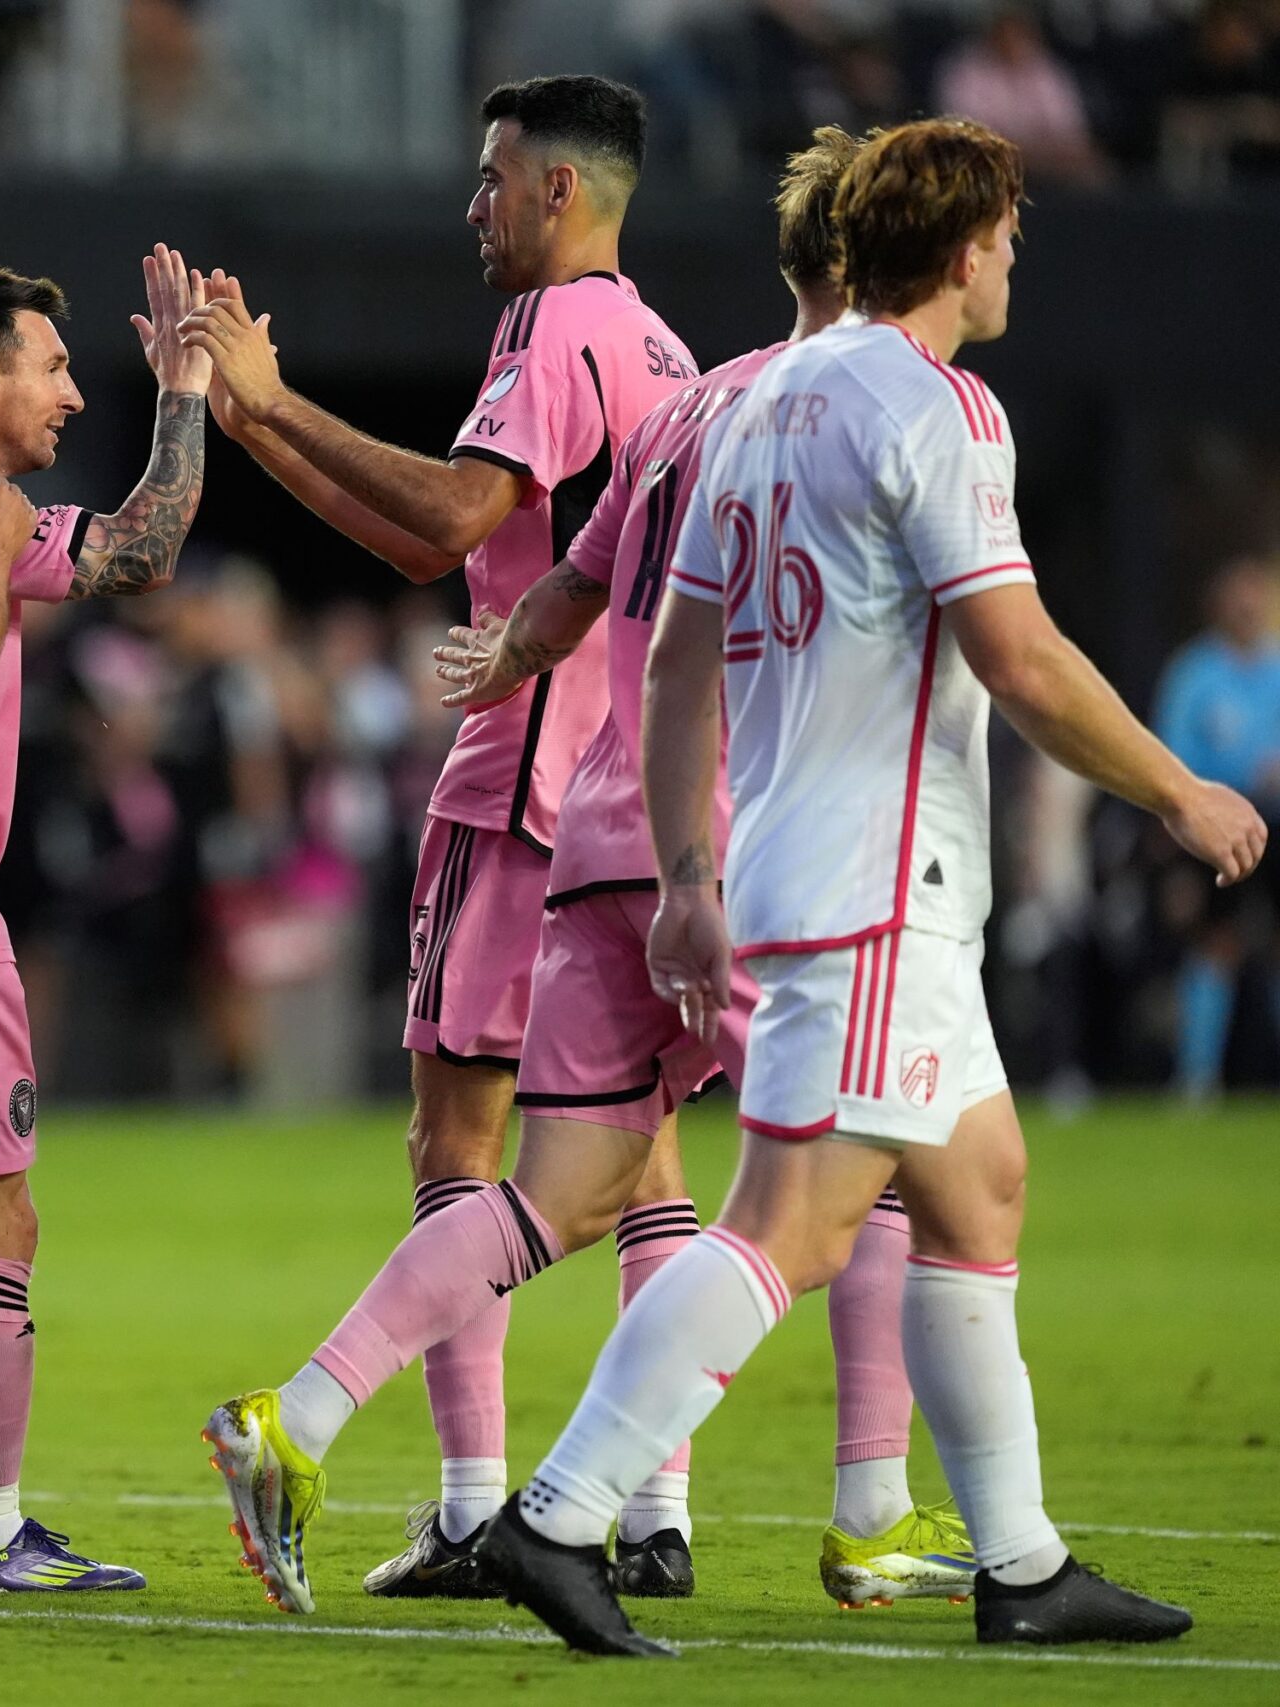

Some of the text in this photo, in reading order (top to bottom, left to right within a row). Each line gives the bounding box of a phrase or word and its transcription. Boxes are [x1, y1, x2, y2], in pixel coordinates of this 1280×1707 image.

[475, 414, 506, 437] tv
[713, 481, 825, 665] 26
[0, 1552, 9, 1562] 10
